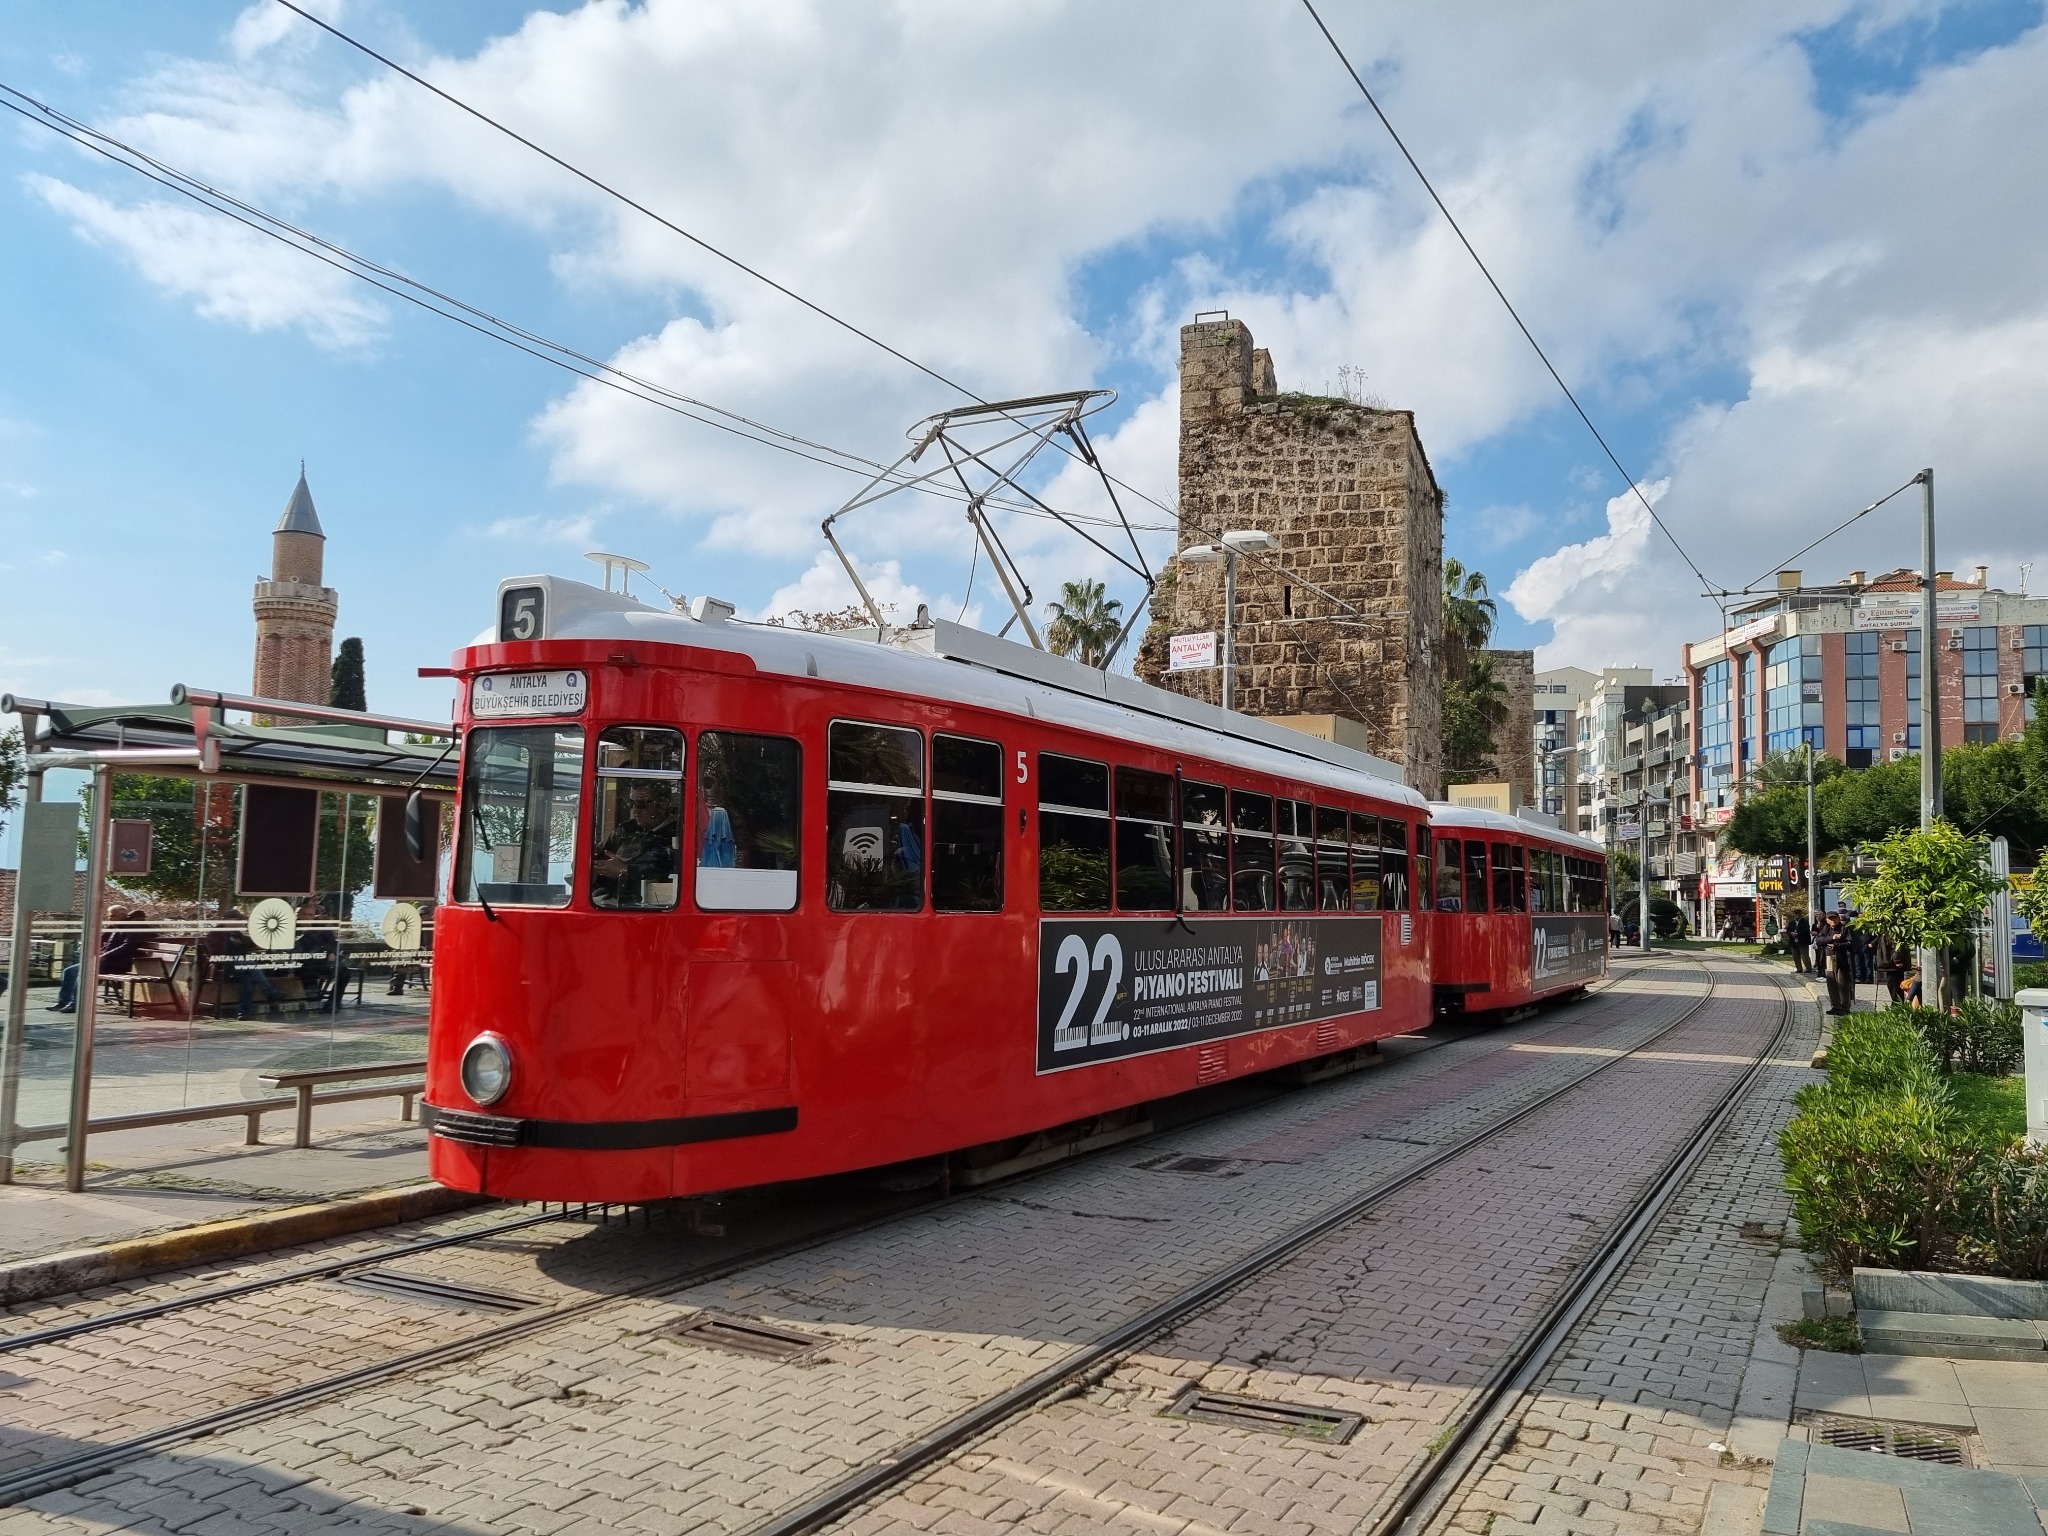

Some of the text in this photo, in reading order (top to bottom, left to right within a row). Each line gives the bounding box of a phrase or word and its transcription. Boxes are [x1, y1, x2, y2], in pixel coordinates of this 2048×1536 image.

[513, 597, 536, 640] 5
[1870, 608, 1894, 617] Eğitim
[1172, 642, 1212, 653] ANTALYAM
[509, 675, 548, 689] ANTALYA
[474, 690, 583, 711] BÜYÜKŞEHİR BELEDİYESİ
[1017, 750, 1028, 784] 5
[1758, 880, 1784, 891] OPTİK
[209, 954, 245, 962] ANTALYA
[1134, 945, 1243, 972] ULUSLARARASI ANTALYA
[1145, 1003, 1187, 1019] INTERNATIONAL
[1187, 1000, 1208, 1012] ANTALYA
[1208, 998, 1223, 1010] PIANO
[1223, 995, 1243, 1007] FESTIVAL
[1132, 1024, 1150, 1038] 03-11
[1150, 1020, 1173, 1035] ARALIK
[1191, 1016, 1205, 1028] 03-11
[1205, 1011, 1231, 1025] DECEMBER
[1231, 1009, 1243, 1021] 2022
